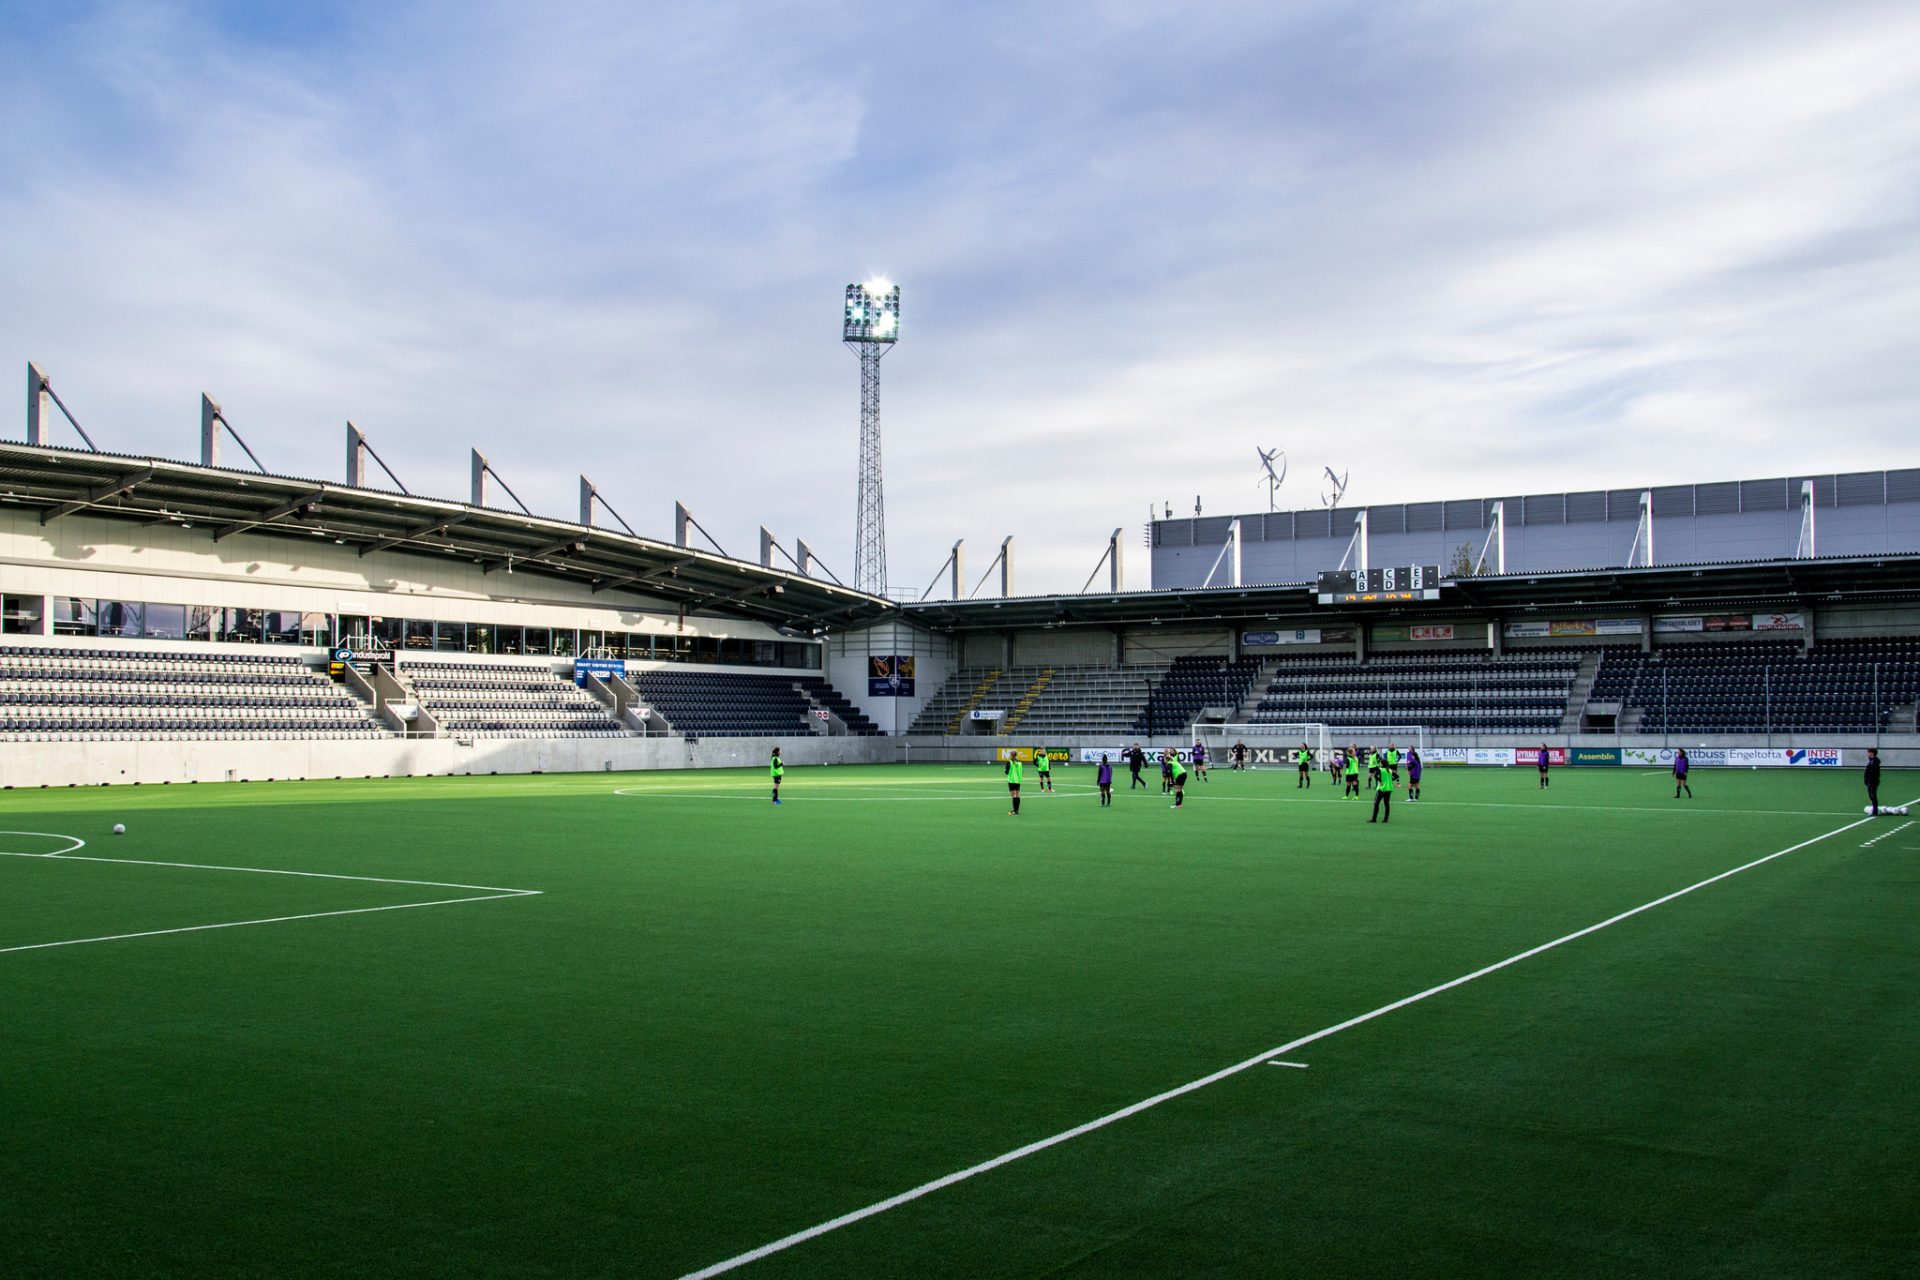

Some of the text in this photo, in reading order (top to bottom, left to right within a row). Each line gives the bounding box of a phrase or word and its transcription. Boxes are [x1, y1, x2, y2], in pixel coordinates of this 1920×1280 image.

[1359, 572, 1365, 580] A
[1387, 570, 1392, 578] C
[1414, 569, 1420, 577] E
[1359, 583, 1365, 591] B
[1386, 581, 1393, 589] D
[1414, 580, 1419, 588] F
[1443, 749, 1465, 757] EIRA
[1729, 749, 1781, 760] Engeltofta
